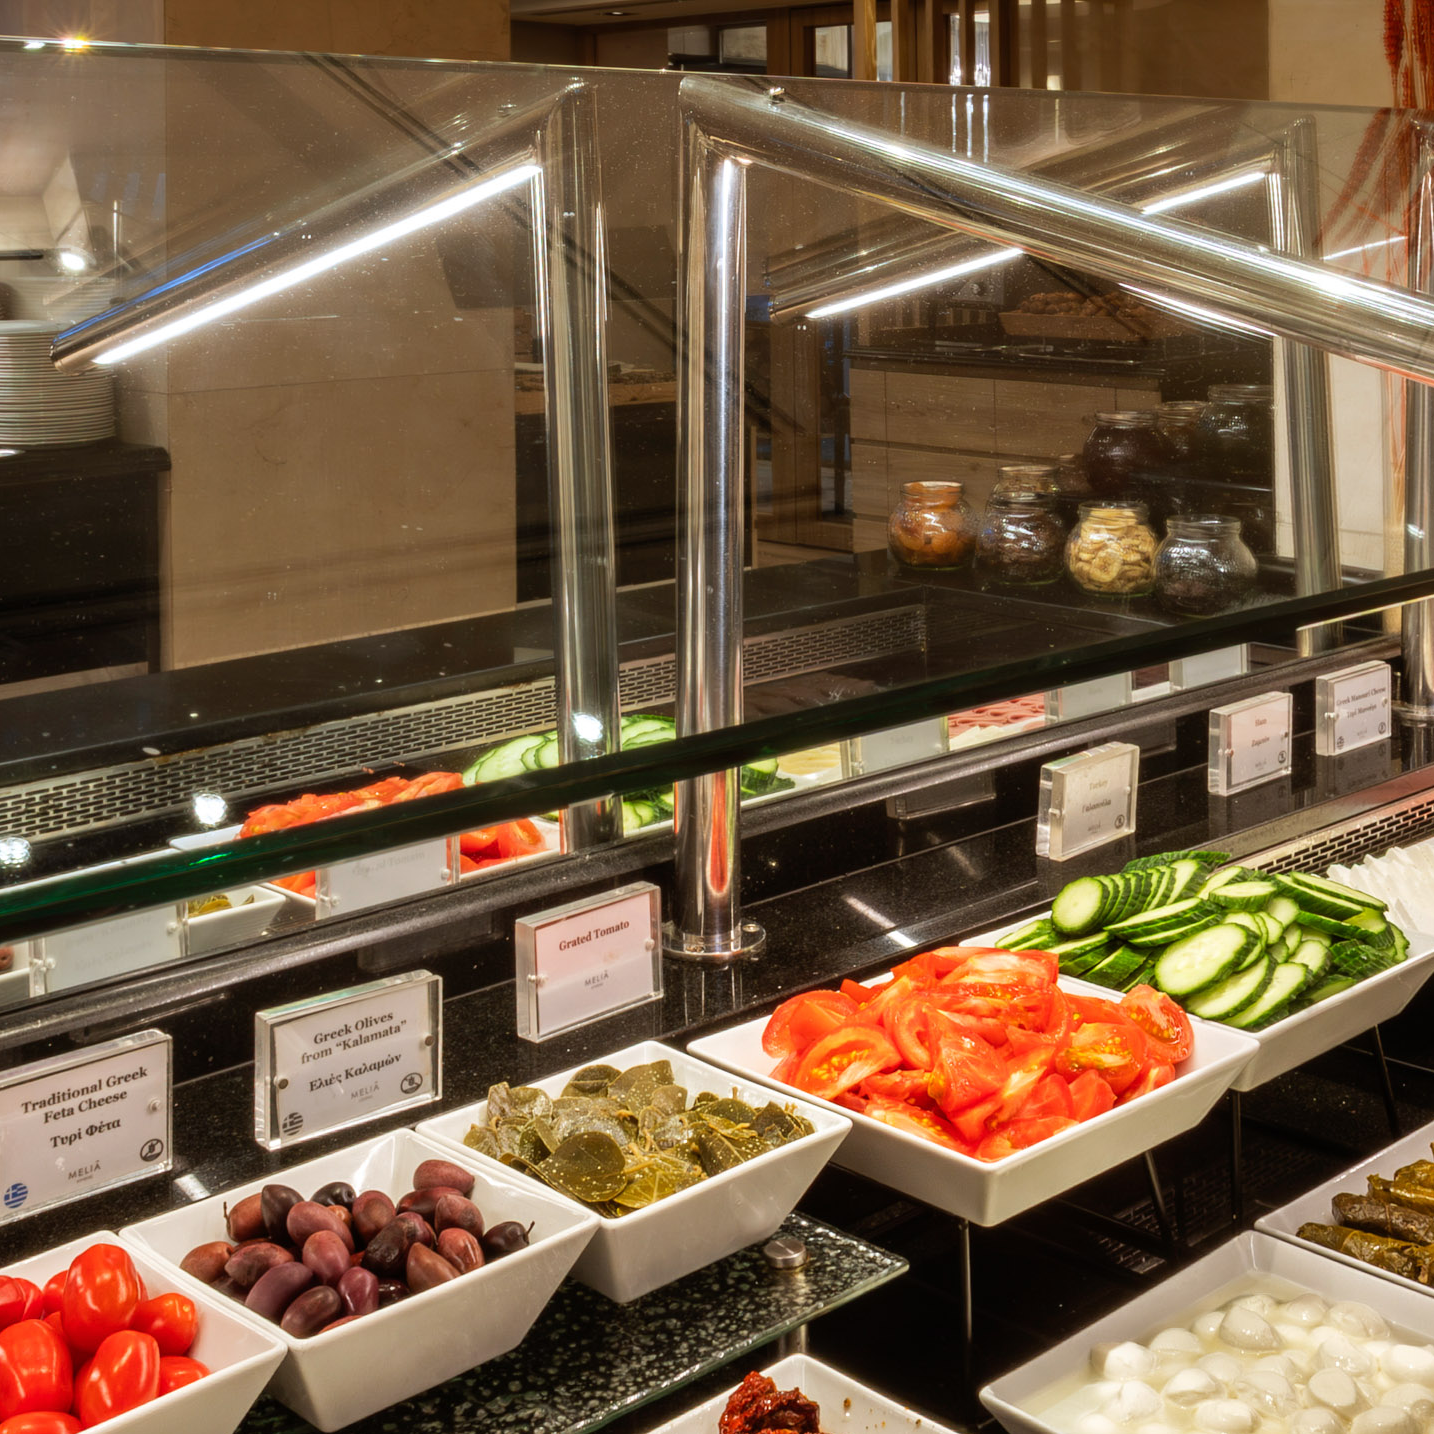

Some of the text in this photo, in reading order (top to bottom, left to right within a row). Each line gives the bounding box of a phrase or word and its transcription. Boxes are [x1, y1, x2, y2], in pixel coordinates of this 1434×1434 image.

[559, 919, 630, 951] Grated Tomato
[313, 1011, 394, 1045] Greek Olives
[300, 1047, 333, 1065] from
[21, 1066, 148, 1114] Traditional Greek
[43, 1090, 127, 1124] Feta Cheese
